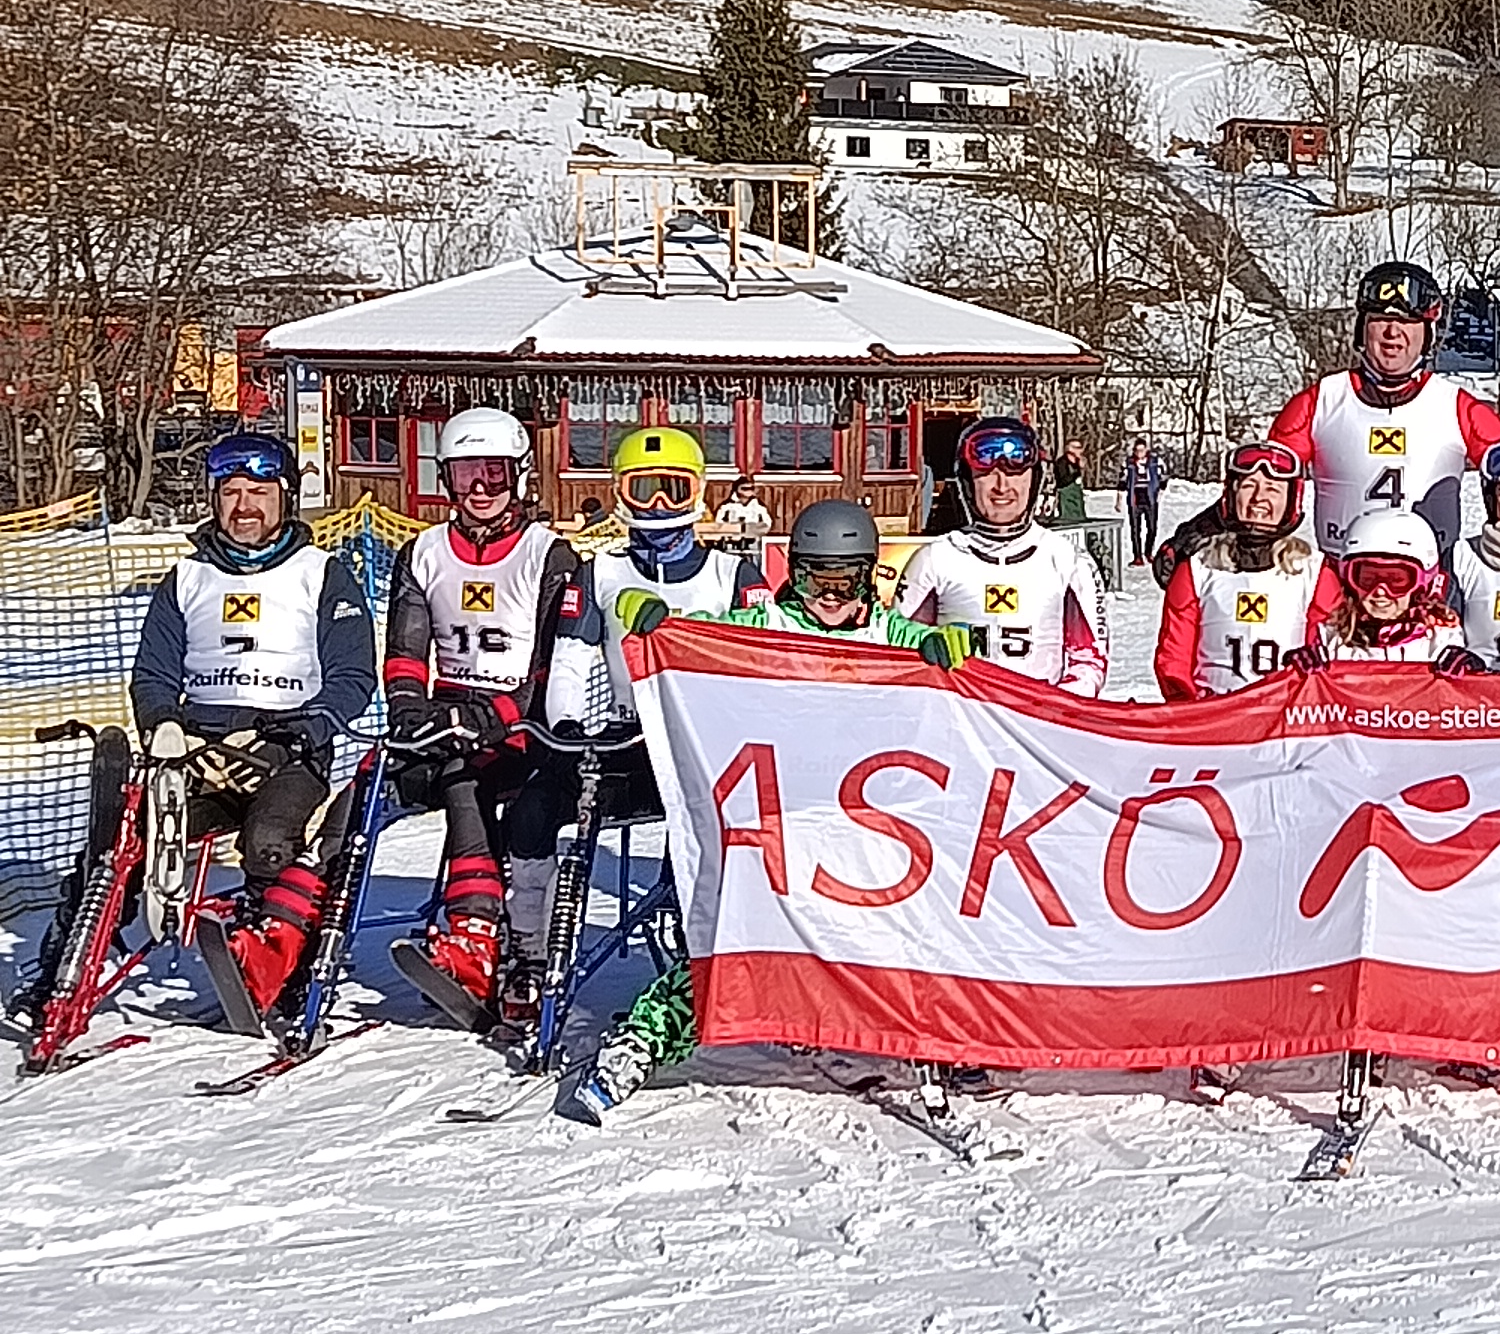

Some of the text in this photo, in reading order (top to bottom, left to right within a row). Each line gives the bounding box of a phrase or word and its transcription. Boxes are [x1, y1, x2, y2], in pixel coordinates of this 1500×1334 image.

[1365, 466, 1405, 509] 4
[1226, 634, 1280, 676] 10
[712, 742, 1243, 931] ASKÖ
